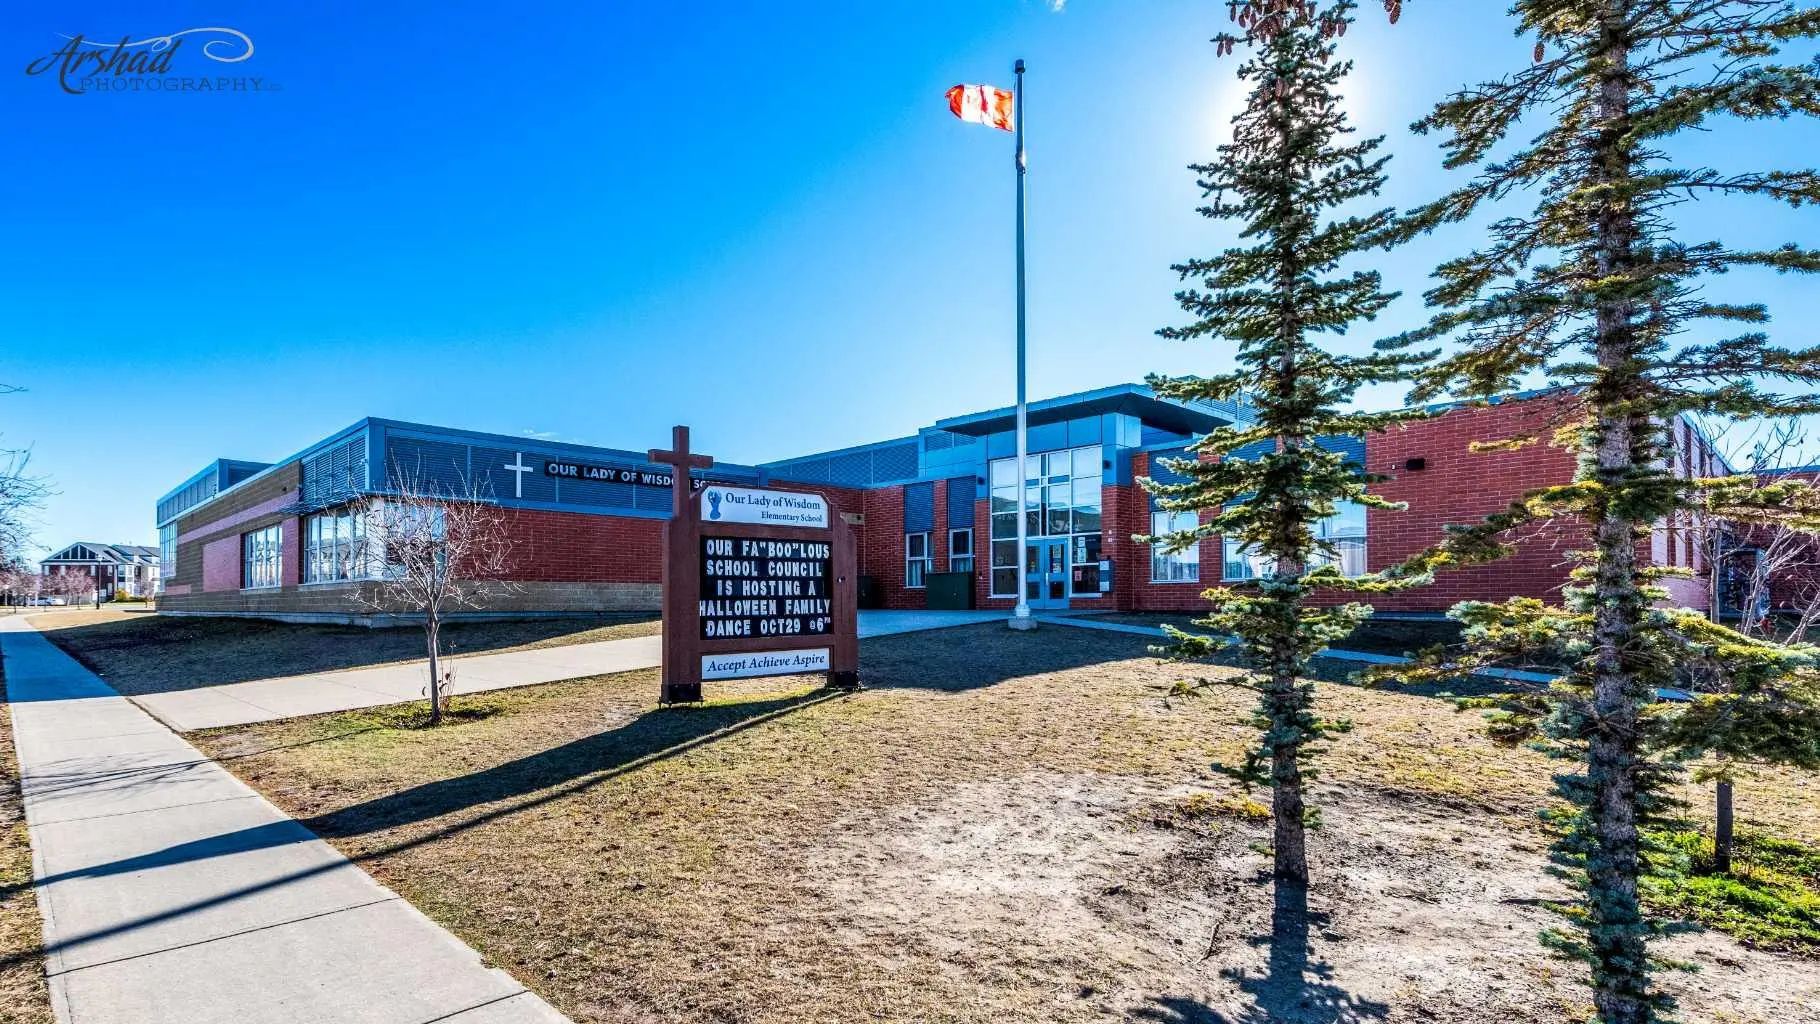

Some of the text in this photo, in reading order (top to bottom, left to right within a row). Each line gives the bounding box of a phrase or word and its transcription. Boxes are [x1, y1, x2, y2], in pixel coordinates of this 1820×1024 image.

[549, 463, 578, 476] OUR
[583, 467, 616, 480] LADY
[620, 471, 638, 482] OF
[725, 492, 821, 510] Our Lady of Wisdom
[761, 511, 823, 523] Elementary School
[706, 539, 734, 556] OUR
[706, 559, 822, 577] SCHOOL COUNCIL
[717, 580, 816, 596] IS HOSTING A
[699, 599, 831, 617] HALLOWEEN FAMILY
[706, 619, 751, 637] DANCE
[707, 653, 825, 673] Accept Achieve Aspire
